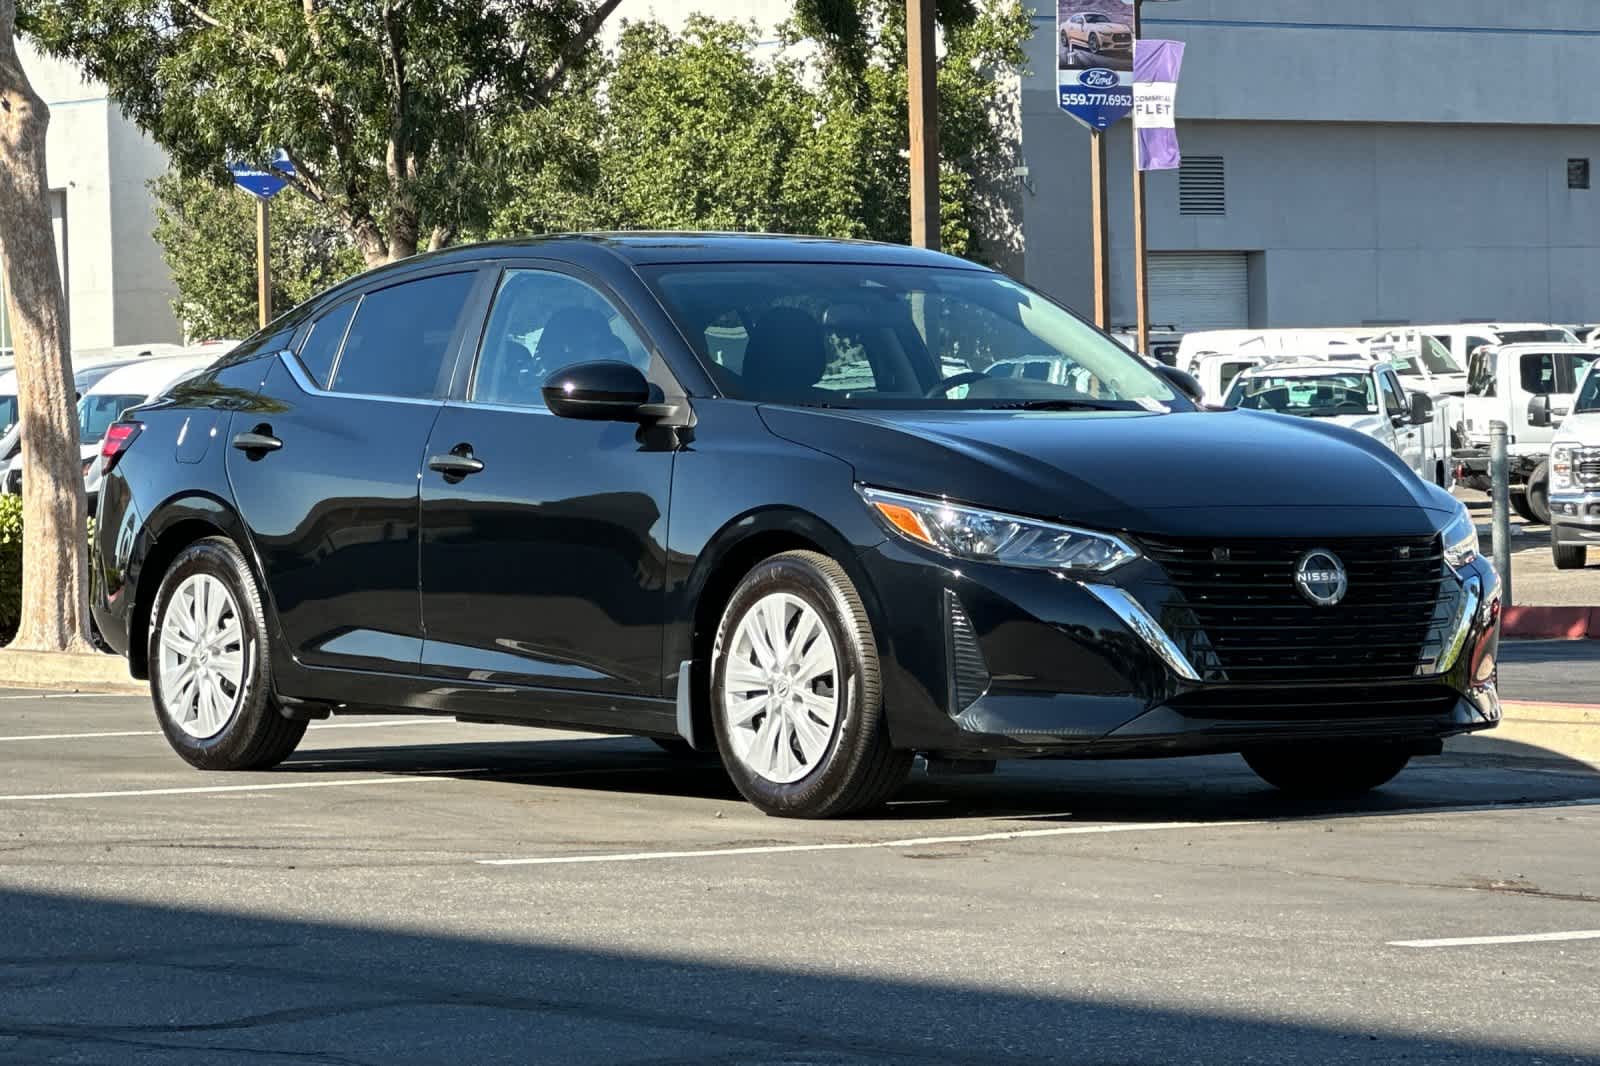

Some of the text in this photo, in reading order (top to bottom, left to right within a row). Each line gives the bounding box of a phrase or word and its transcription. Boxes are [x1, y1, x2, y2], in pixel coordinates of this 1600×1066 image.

[1087, 70, 1113, 85] Ford
[1062, 93, 1132, 106] 559.777.6952
[1297, 572, 1345, 582] NISSAN
